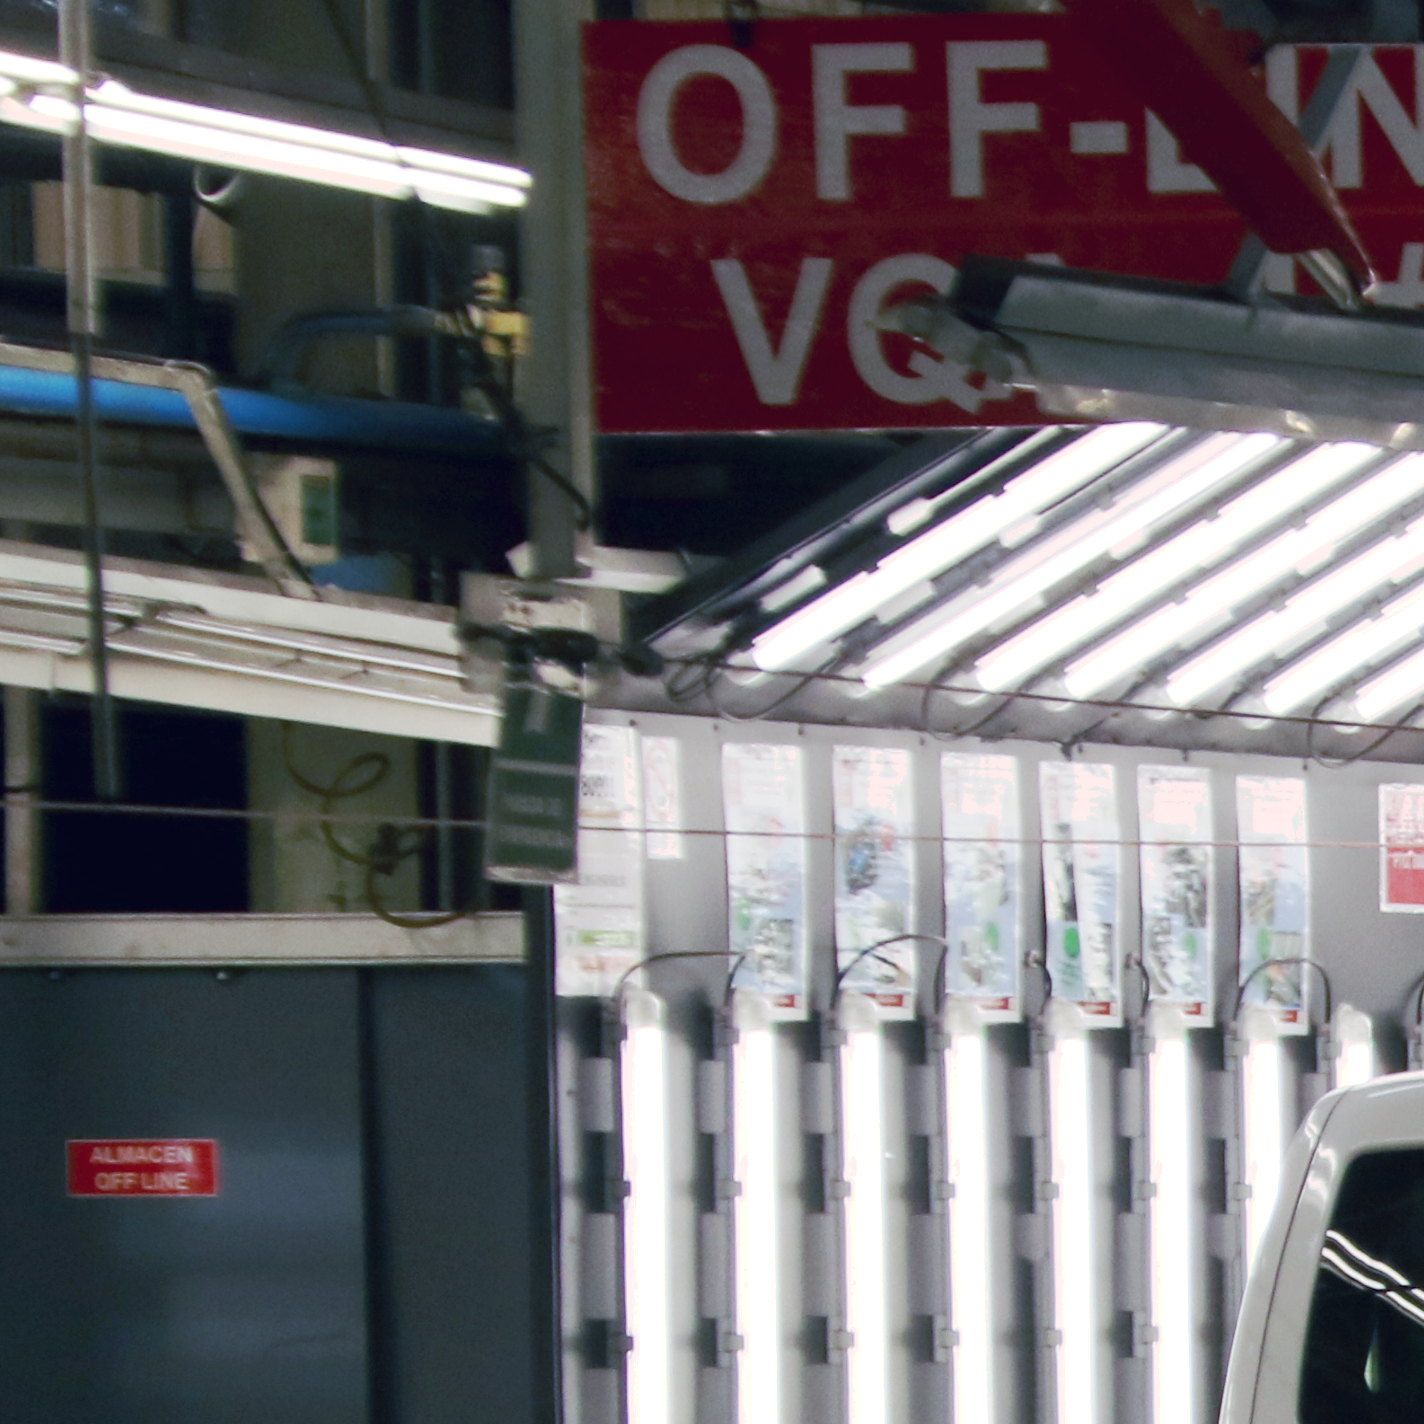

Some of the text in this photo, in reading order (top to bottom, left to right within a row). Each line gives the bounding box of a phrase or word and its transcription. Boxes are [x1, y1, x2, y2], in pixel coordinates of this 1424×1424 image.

[89, 1146, 194, 1164] ALMACEN
[94, 1172, 189, 1190] OFF LINE
